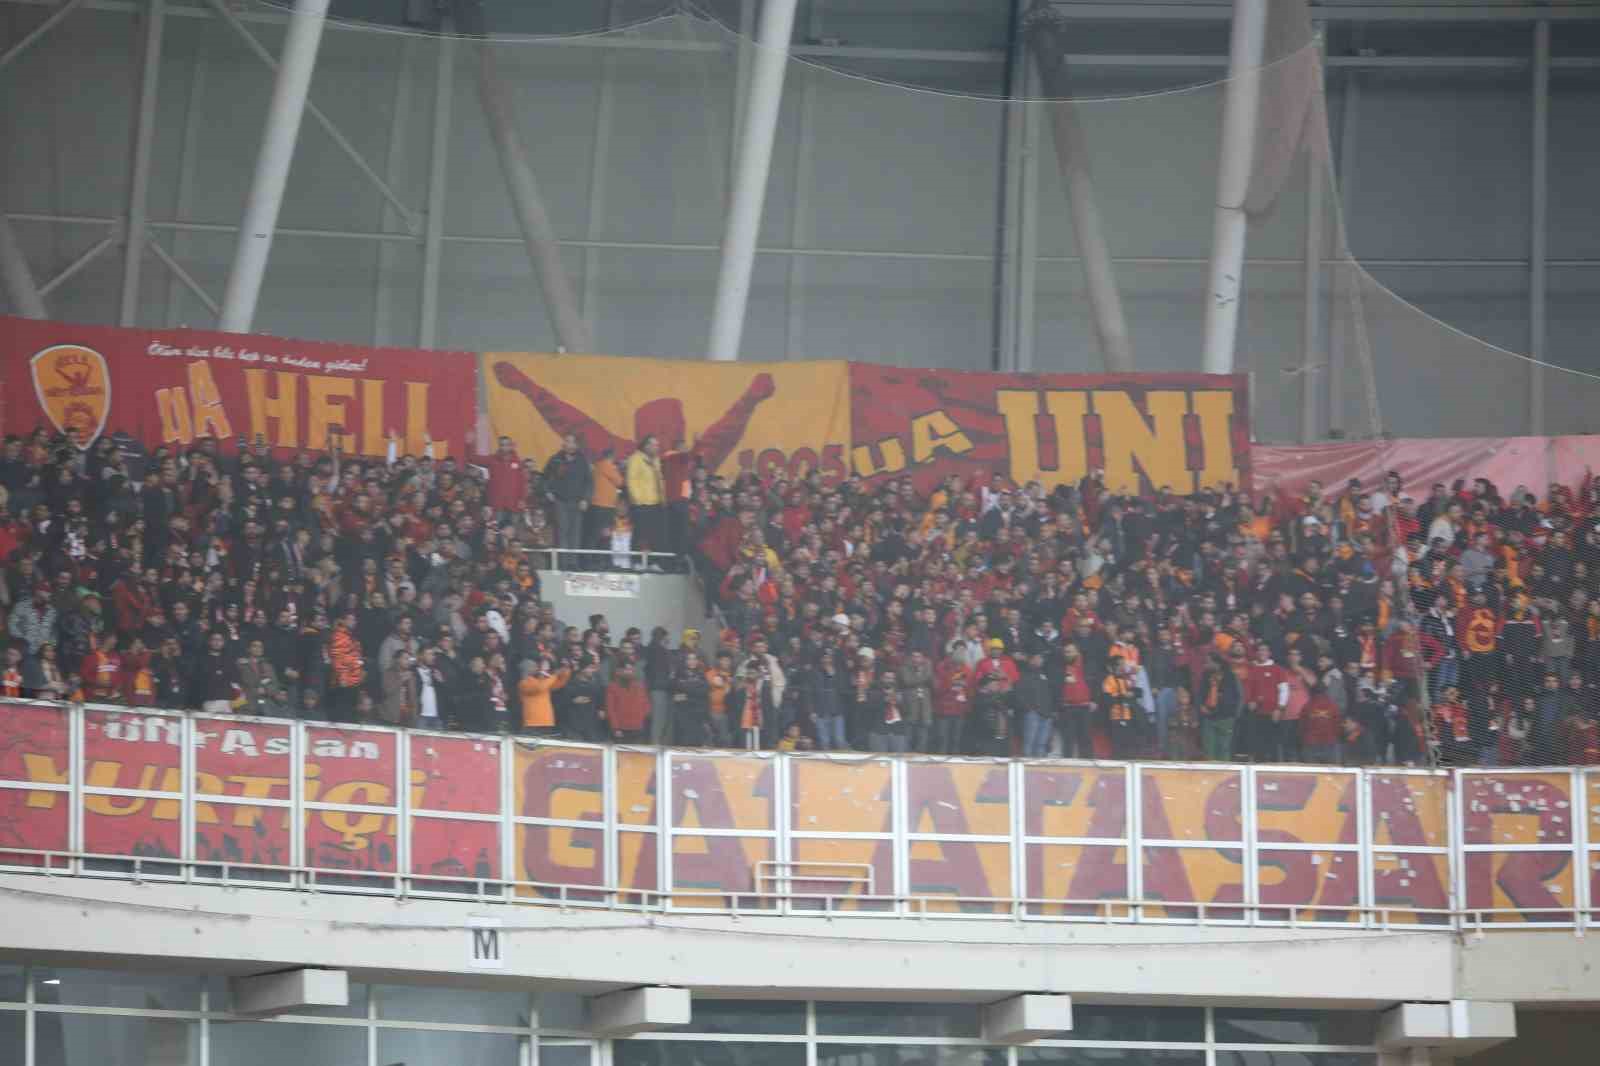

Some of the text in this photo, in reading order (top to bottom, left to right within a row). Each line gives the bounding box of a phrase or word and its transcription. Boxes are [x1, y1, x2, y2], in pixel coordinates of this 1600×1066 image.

[244, 368, 449, 461] HELL
[995, 390, 1240, 497] UNI
[103, 714, 380, 760] ultrAsan
[523, 752, 1600, 921] GALATASAR
[472, 928, 499, 960] M
